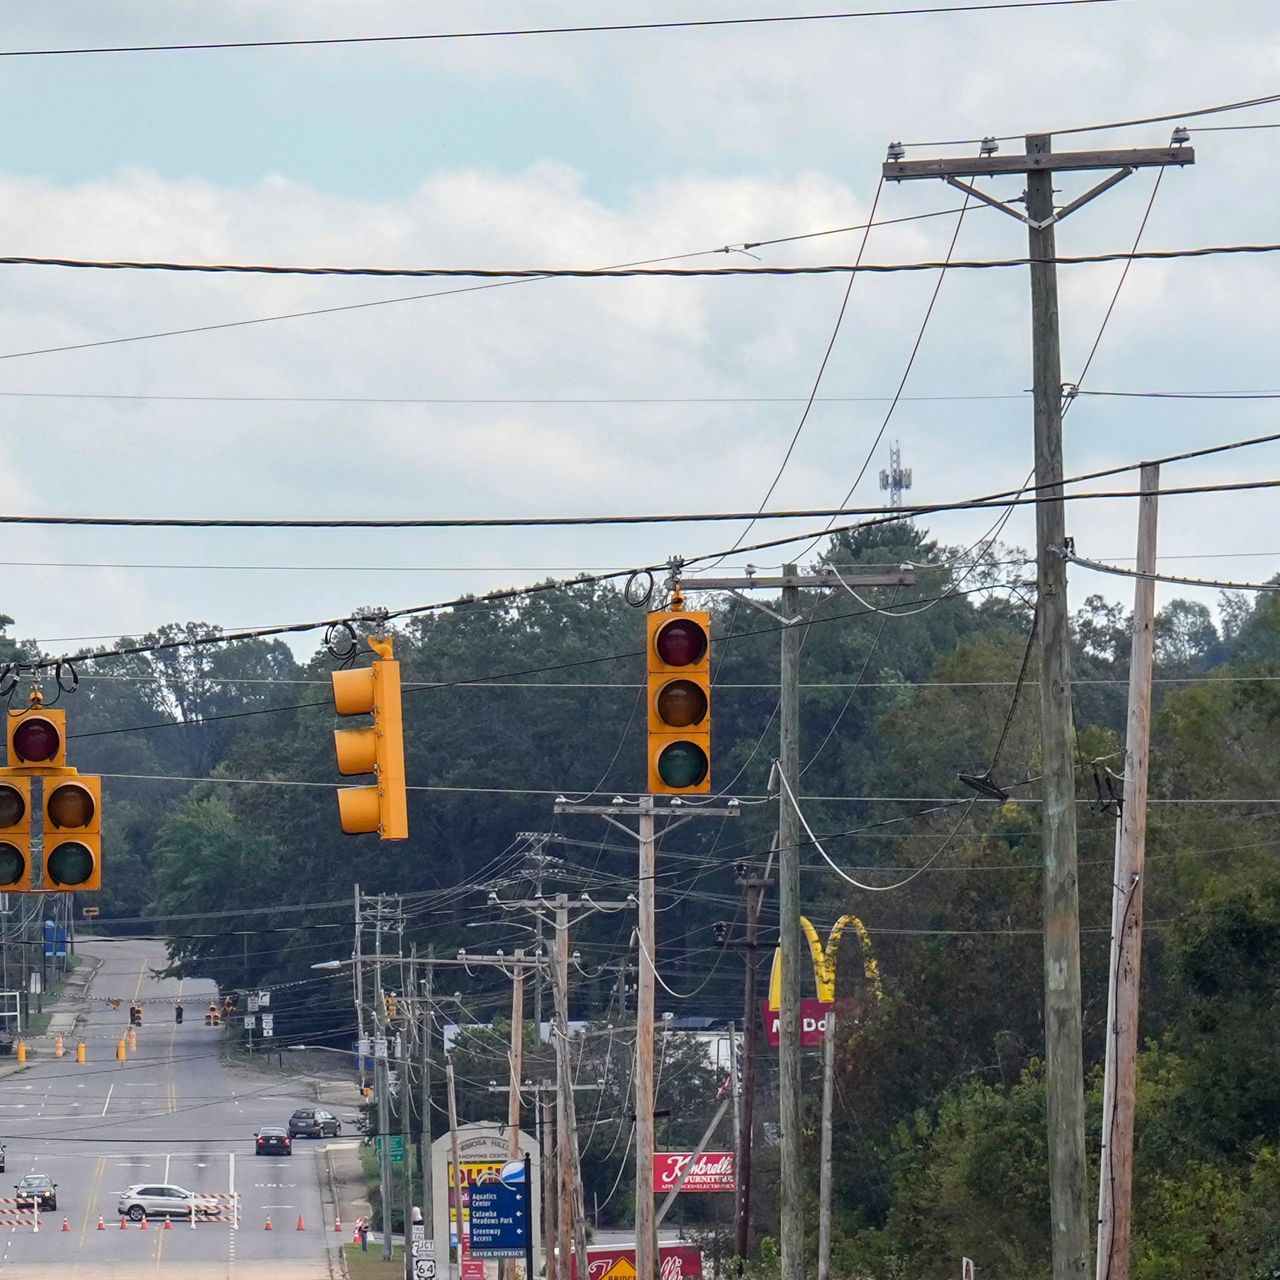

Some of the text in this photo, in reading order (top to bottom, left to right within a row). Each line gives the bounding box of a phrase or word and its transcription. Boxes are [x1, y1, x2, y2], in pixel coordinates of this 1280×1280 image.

[661, 1155, 733, 1182] Kmbrell's
[473, 1228, 501, 1236] Greenway
[420, 1241, 433, 1249] JCT
[418, 1264, 433, 1274] 64
